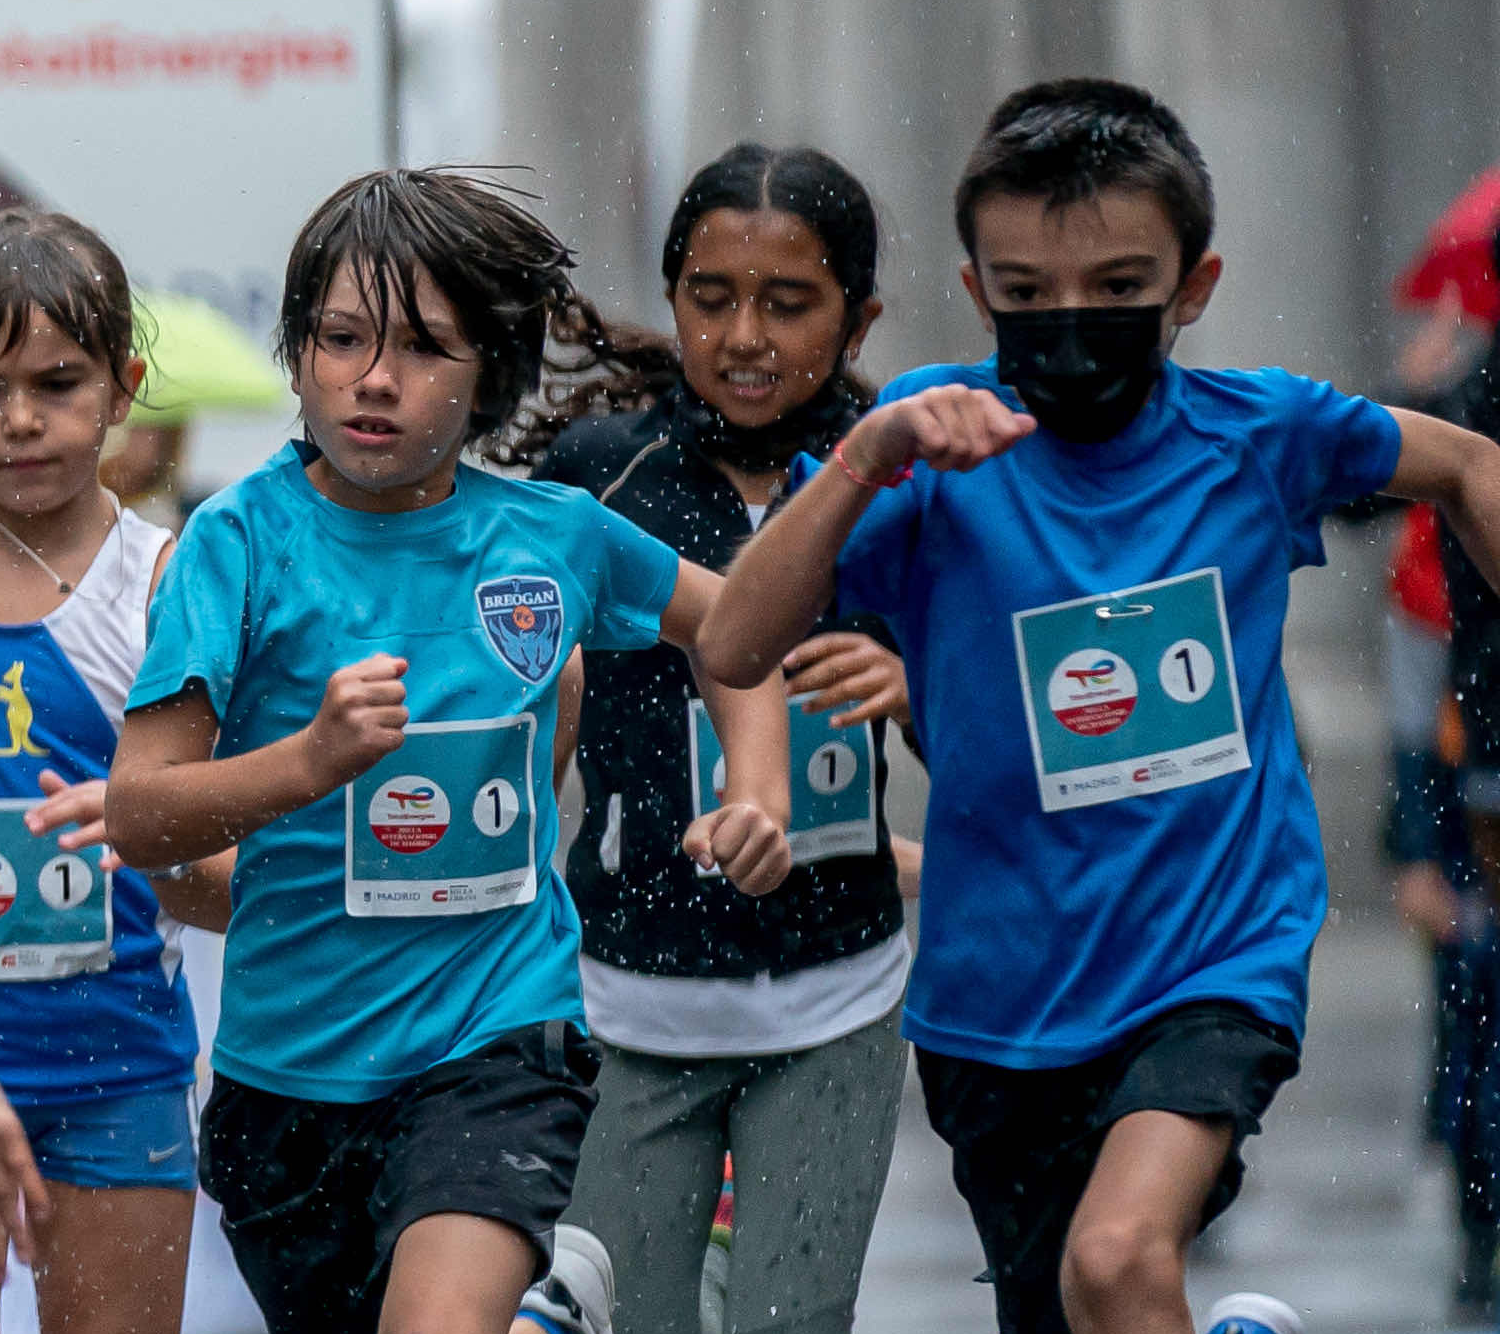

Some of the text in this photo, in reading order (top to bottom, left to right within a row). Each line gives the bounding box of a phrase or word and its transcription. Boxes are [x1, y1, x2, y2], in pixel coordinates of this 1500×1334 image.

[1175, 647, 1196, 693] 1
[821, 750, 836, 786] 1
[488, 787, 502, 829] 1
[55, 861, 70, 902] 1
[377, 891, 421, 902] MADRID
